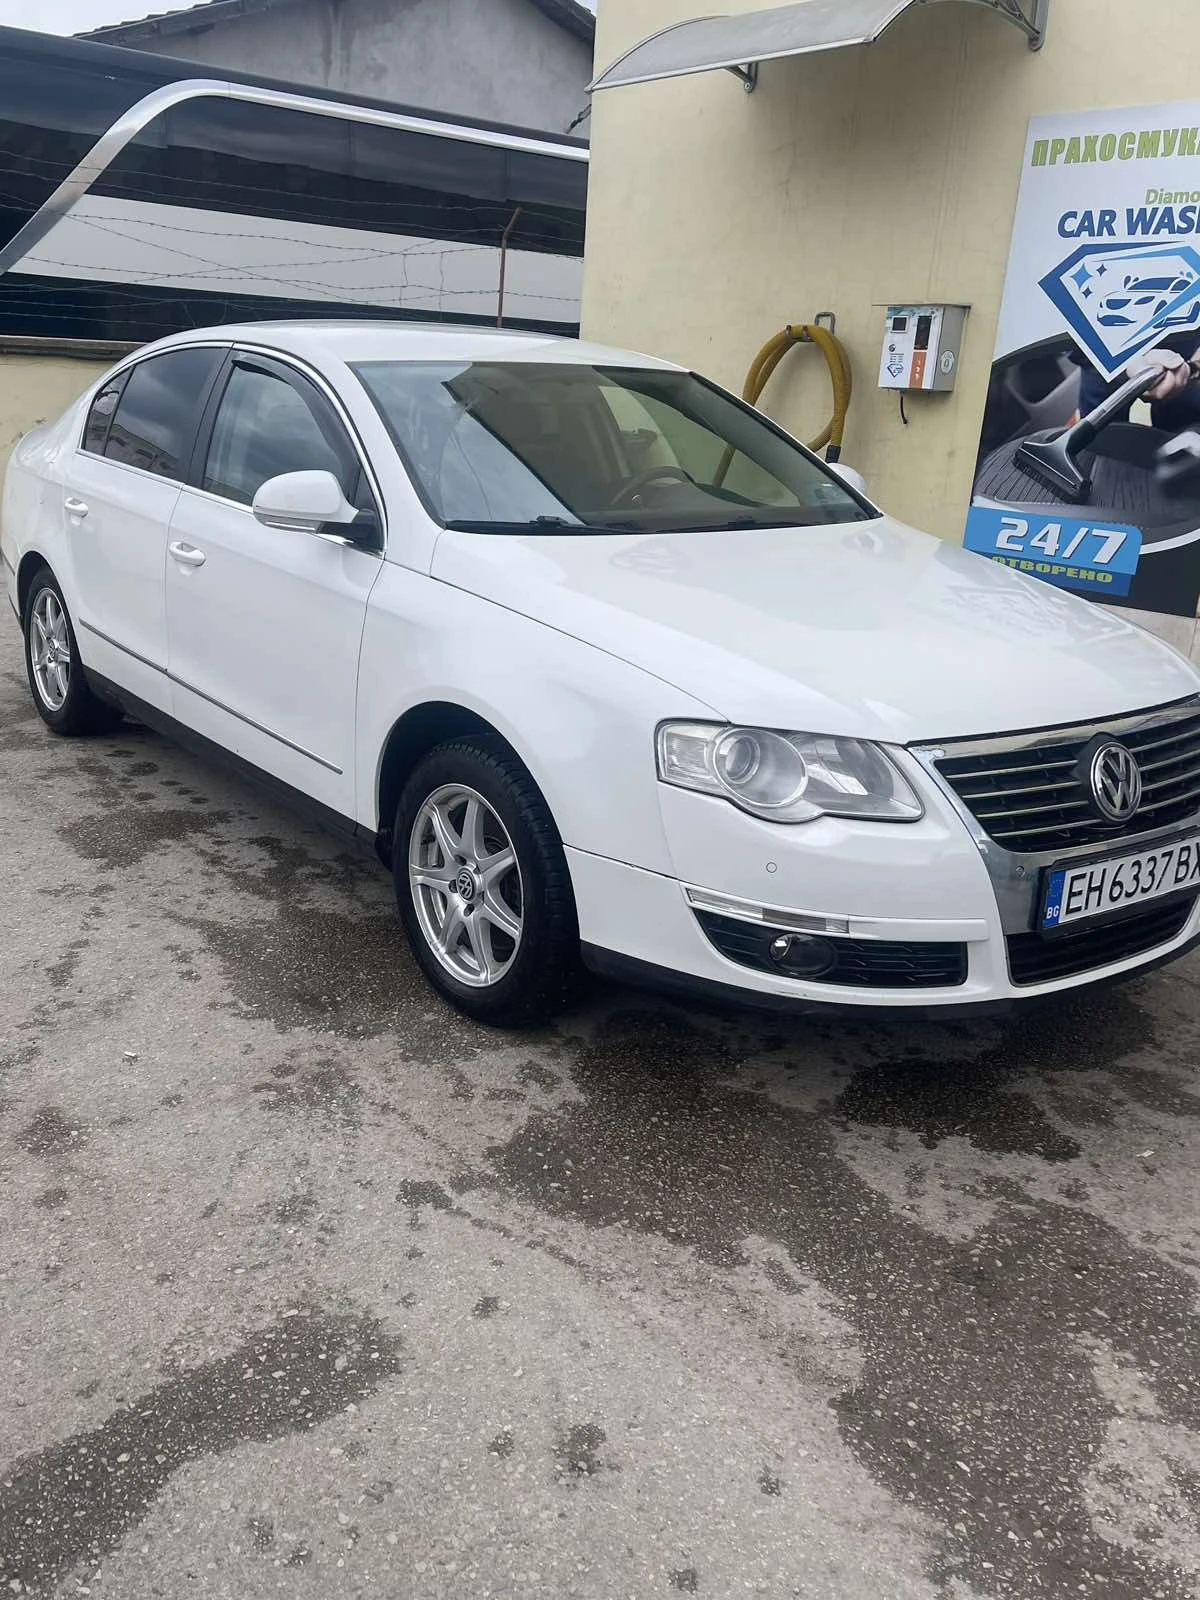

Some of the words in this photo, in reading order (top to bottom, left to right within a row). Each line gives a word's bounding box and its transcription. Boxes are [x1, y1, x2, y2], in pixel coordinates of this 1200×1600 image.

[1031, 127, 1200, 167] ПРАХОСМУК
[1057, 209, 1117, 238] CAR
[1125, 205, 1200, 236] WAS
[995, 516, 1128, 565] 24/7
[1046, 905, 1060, 919] BG
